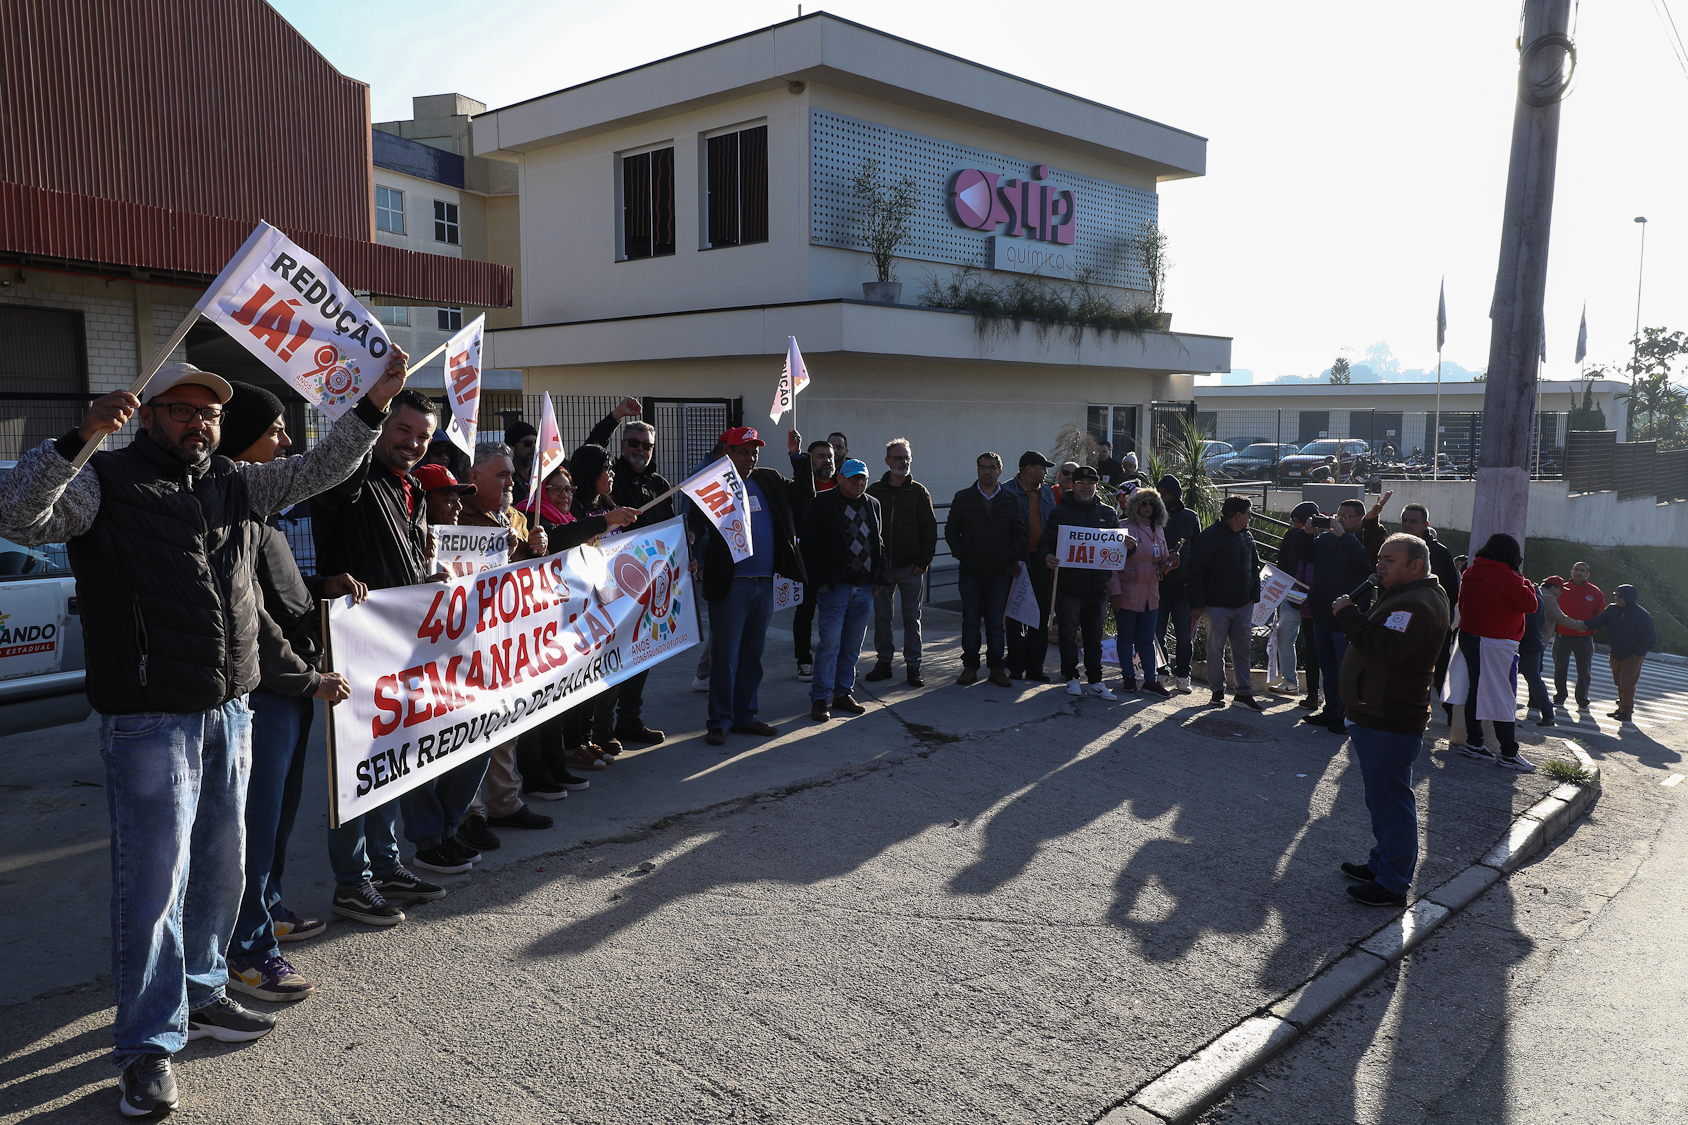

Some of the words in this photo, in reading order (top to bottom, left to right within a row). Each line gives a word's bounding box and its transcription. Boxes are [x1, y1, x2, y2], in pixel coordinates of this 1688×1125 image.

[1006, 244, 1065, 269] química
[270, 252, 387, 358] REDUÇÃO
[231, 284, 314, 363] JÁ!
[296, 375, 312, 390] ANOS
[302, 345, 352, 394] 90
[450, 350, 479, 406] JÁ!
[292, 379, 320, 402] CONSTRUINDO
[694, 481, 737, 518] JÁ!
[441, 533, 505, 556] REDUÇÃO
[1069, 531, 1124, 543] REDUÇÃO
[1067, 542, 1095, 564] JÁ!
[1100, 548, 1120, 565] 90
[417, 585, 467, 644] 40
[476, 557, 571, 634] HORAS
[6, 644, 50, 656] ESTADUAL
[632, 638, 650, 656] ANOS
[633, 644, 666, 666] CONSTRUINDO
[671, 634, 688, 648] FUTURO
[372, 621, 568, 739] SEMANAIS
[569, 598, 616, 656] JÁ!
[356, 742, 410, 798] SEM
[417, 697, 527, 769] REDUÇÃO
[525, 683, 554, 716] DE
[552, 646, 624, 700] SALÁRIO!
